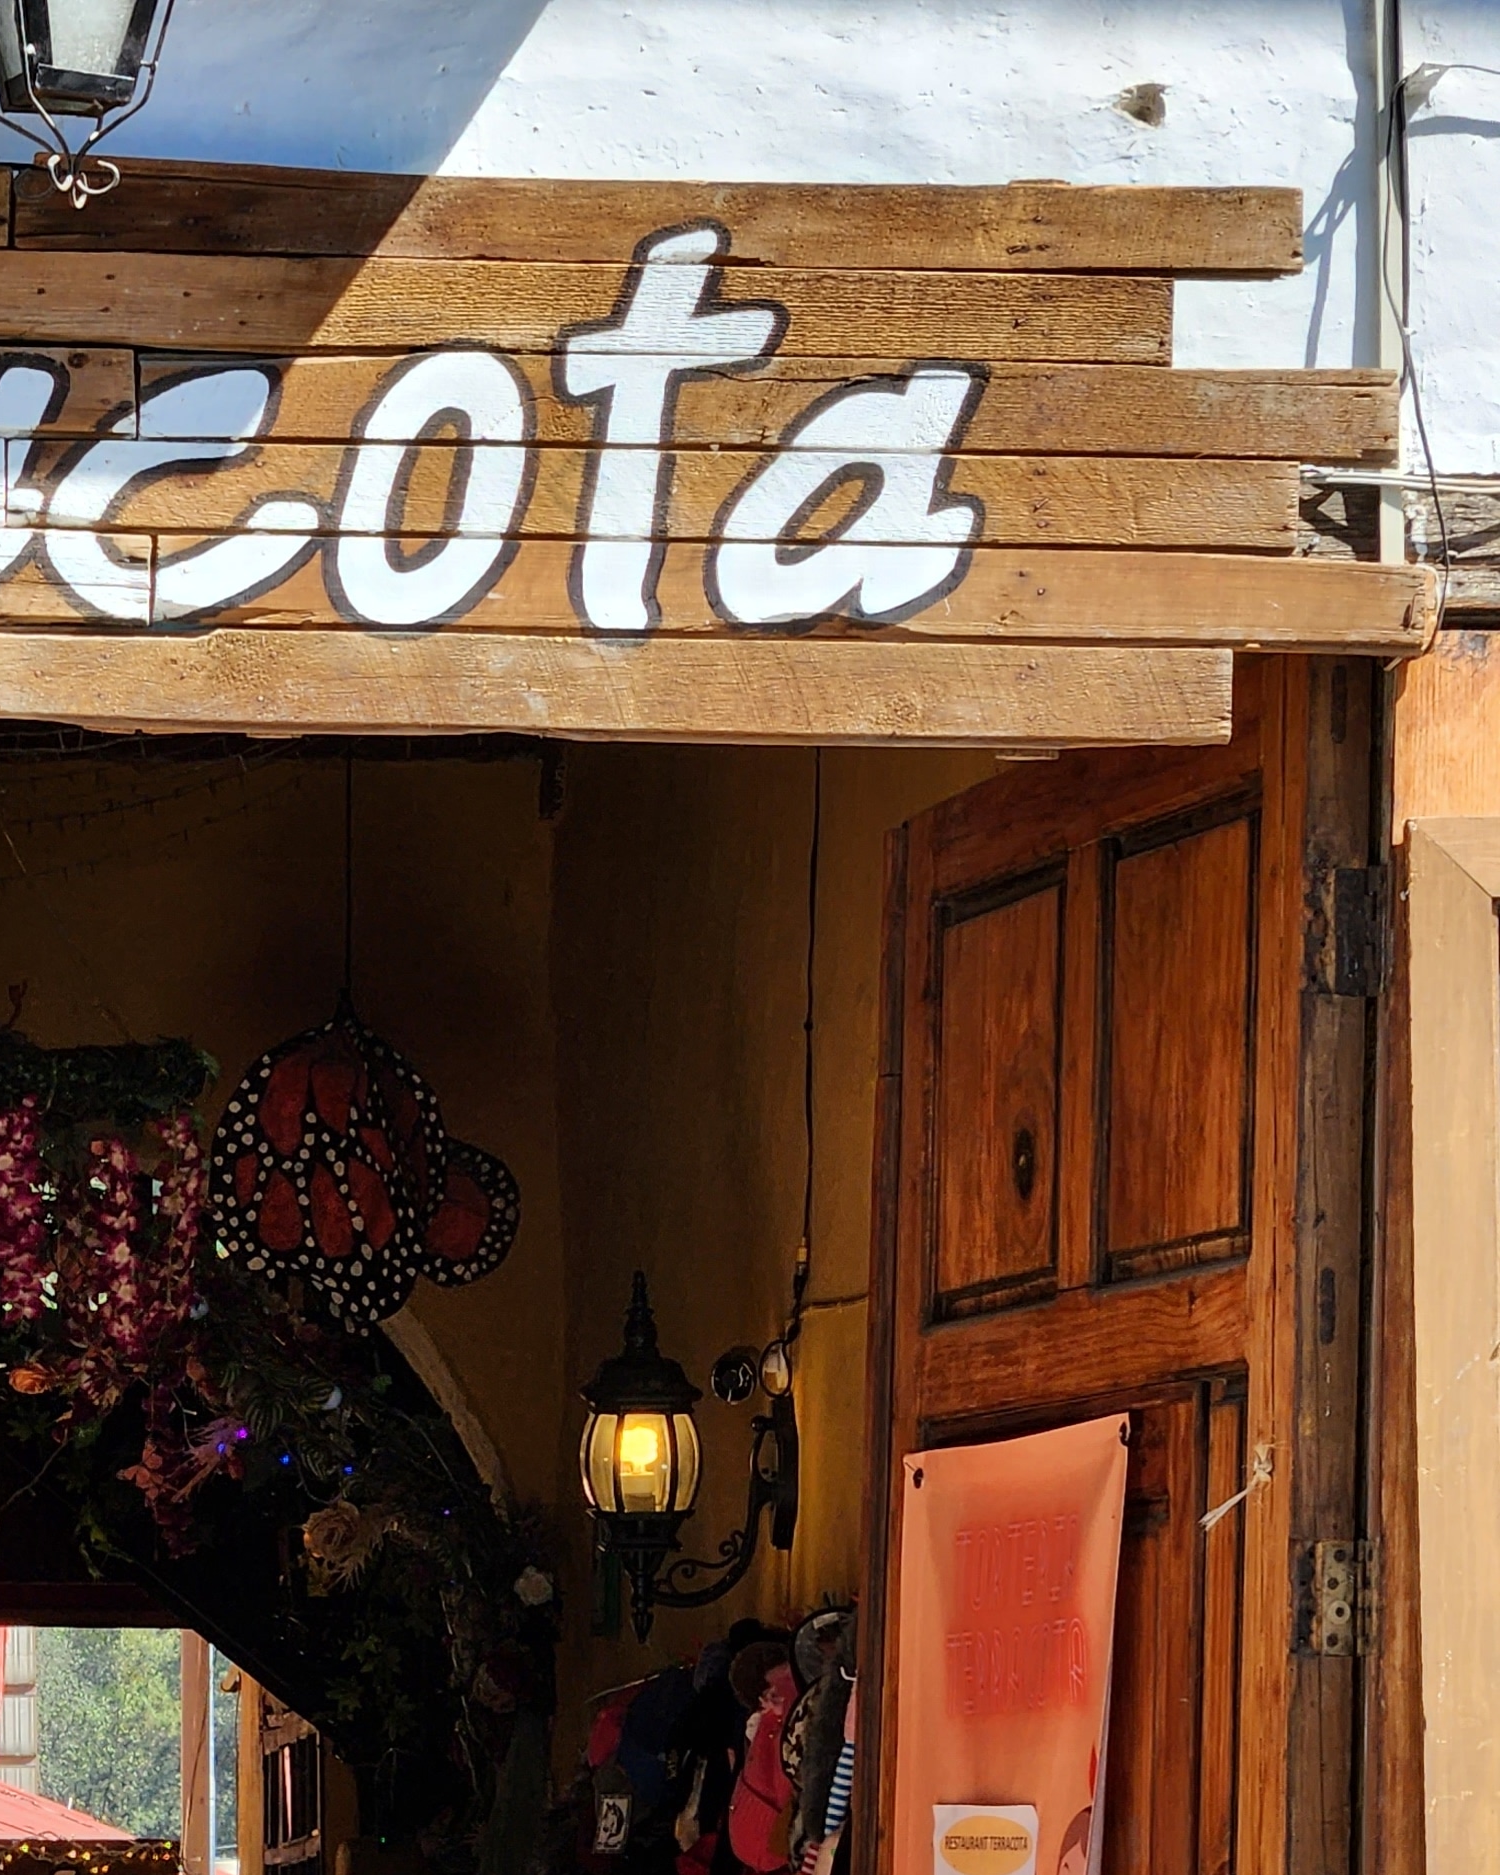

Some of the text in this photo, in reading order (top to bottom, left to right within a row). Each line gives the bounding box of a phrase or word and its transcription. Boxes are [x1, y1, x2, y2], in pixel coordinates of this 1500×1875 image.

[945, 1617, 1088, 1716] TERRACOTA
[944, 1835, 1028, 1851] RESTAURANT TERRACOTA
